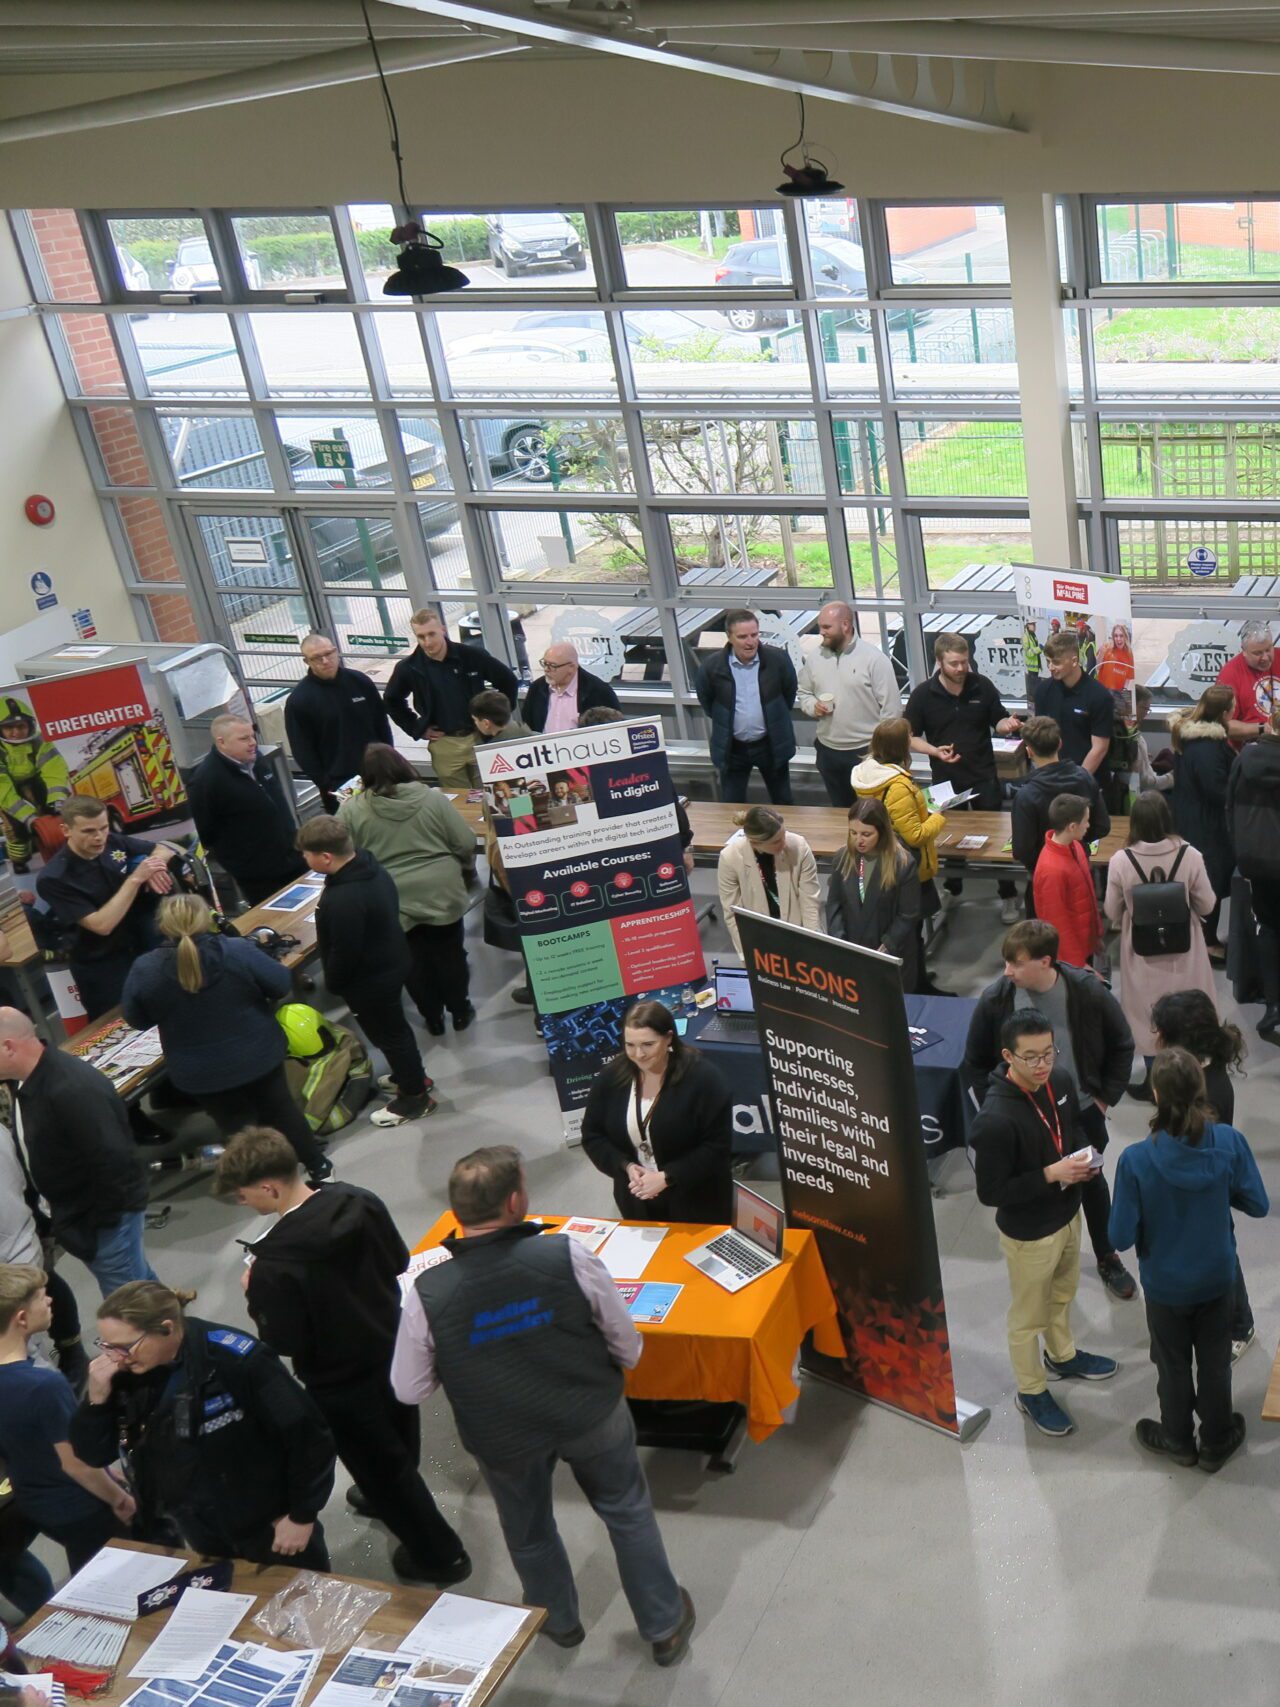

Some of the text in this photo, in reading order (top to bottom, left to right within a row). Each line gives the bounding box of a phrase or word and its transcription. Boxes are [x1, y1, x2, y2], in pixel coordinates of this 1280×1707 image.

[312, 442, 349, 452] Fire exit
[358, 637, 374, 645] Push
[376, 637, 385, 646] bar
[45, 703, 145, 736] FIREFIGHTER
[631, 731, 656, 740] Ofsted
[515, 738, 622, 770] althaus
[608, 772, 650, 788] Leaders
[611, 781, 660, 799] in digital
[505, 822, 676, 860] develops careers within the digital tech industry.
[515, 835, 562, 850] Outstanding
[563, 829, 592, 841] training
[593, 823, 623, 836] provider
[625, 820, 641, 829] that
[642, 814, 667, 826] creates
[543, 851, 652, 880] Available Courses:
[620, 906, 690, 929] APPRENTICESHIPS
[538, 930, 591, 947] BOOTCAMPS
[753, 948, 859, 1003] NELSONS
[757, 975, 860, 1015] Business Law Personal Law Investment
[765, 1028, 854, 1077] Supporting
[768, 1051, 859, 1100] businesses,
[772, 1074, 857, 1119] individuals
[861, 1111, 890, 1133] and
[776, 1098, 839, 1132] families
[841, 1122, 875, 1149] with
[779, 1121, 890, 1177] their legal and
[782, 1142, 871, 1189] investment
[786, 1166, 834, 1194] needs
[792, 1209, 868, 1245] nelsonslaw.co.uk
